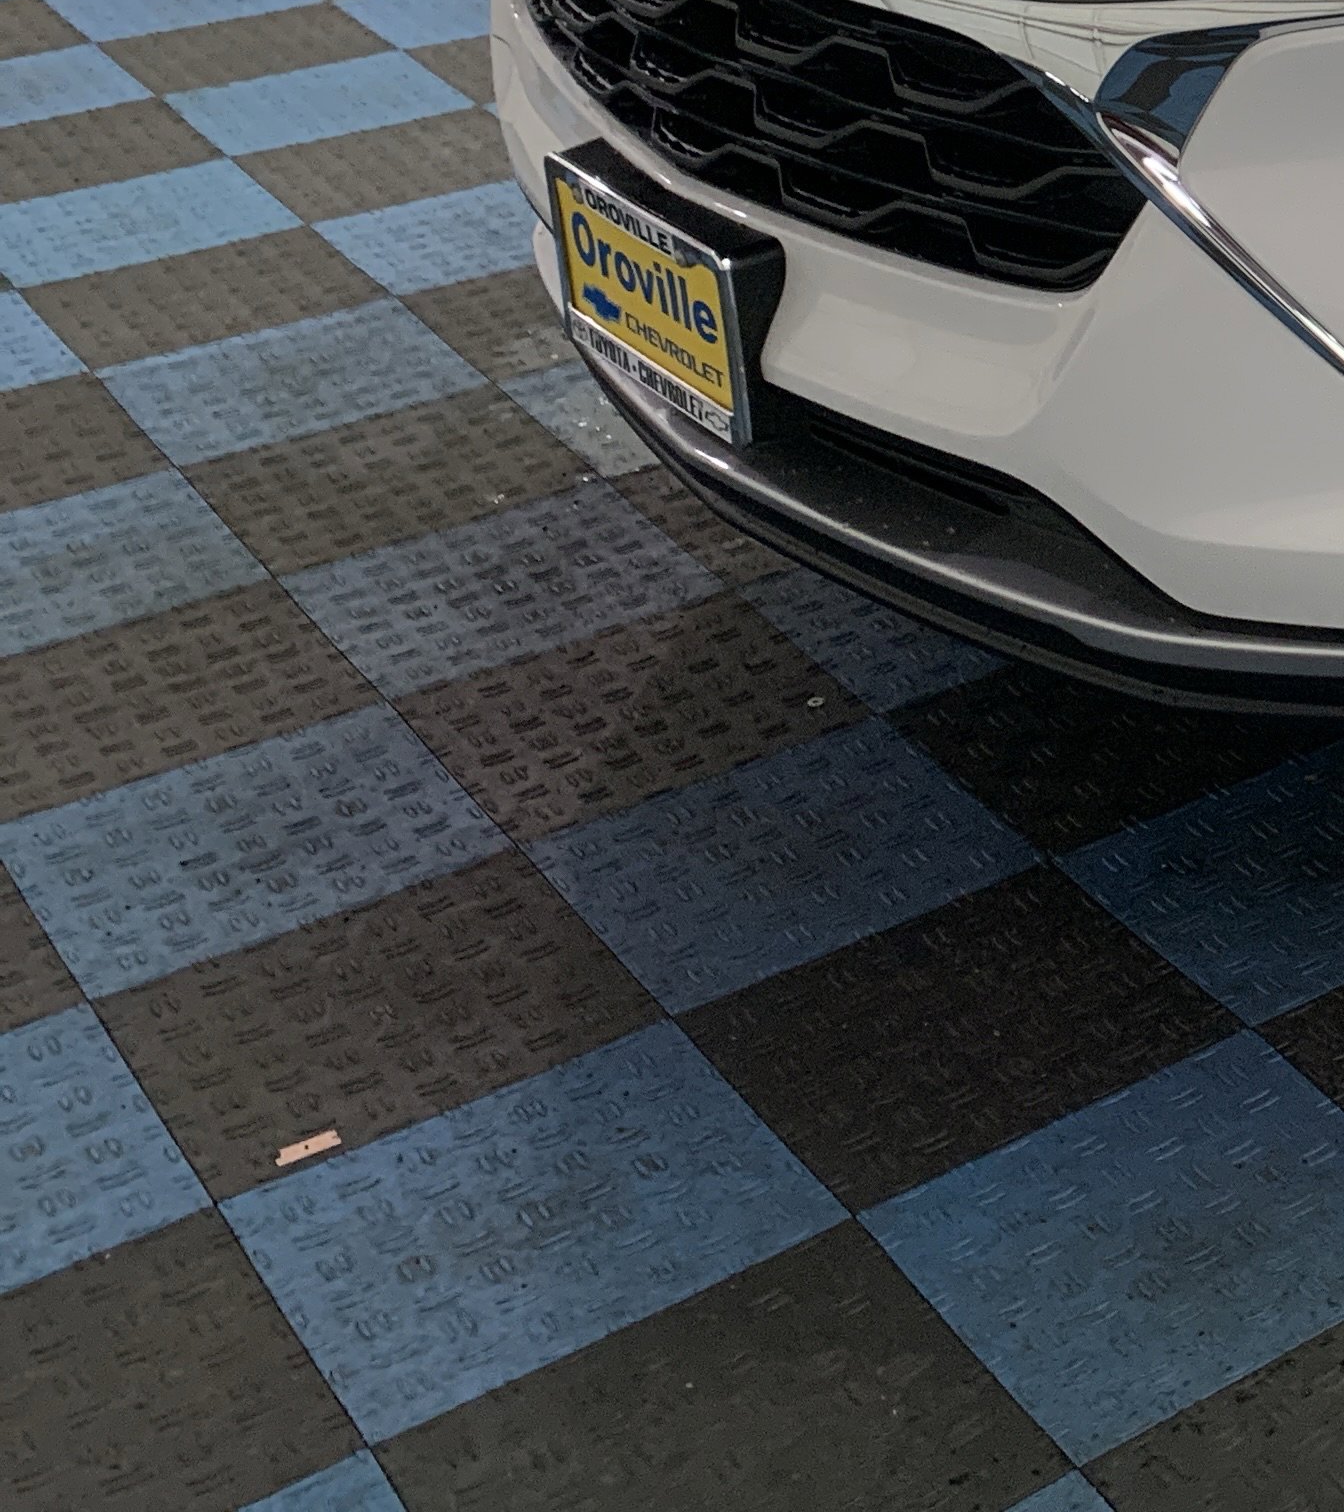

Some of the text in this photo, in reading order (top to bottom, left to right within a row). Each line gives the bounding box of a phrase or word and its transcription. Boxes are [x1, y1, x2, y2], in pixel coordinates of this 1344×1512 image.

[585, 190, 672, 255] OROVILLE
[571, 211, 718, 344] Oroville
[588, 328, 704, 422] TOYOTA CHEVROLET
[624, 310, 725, 389] CHEVROLET
